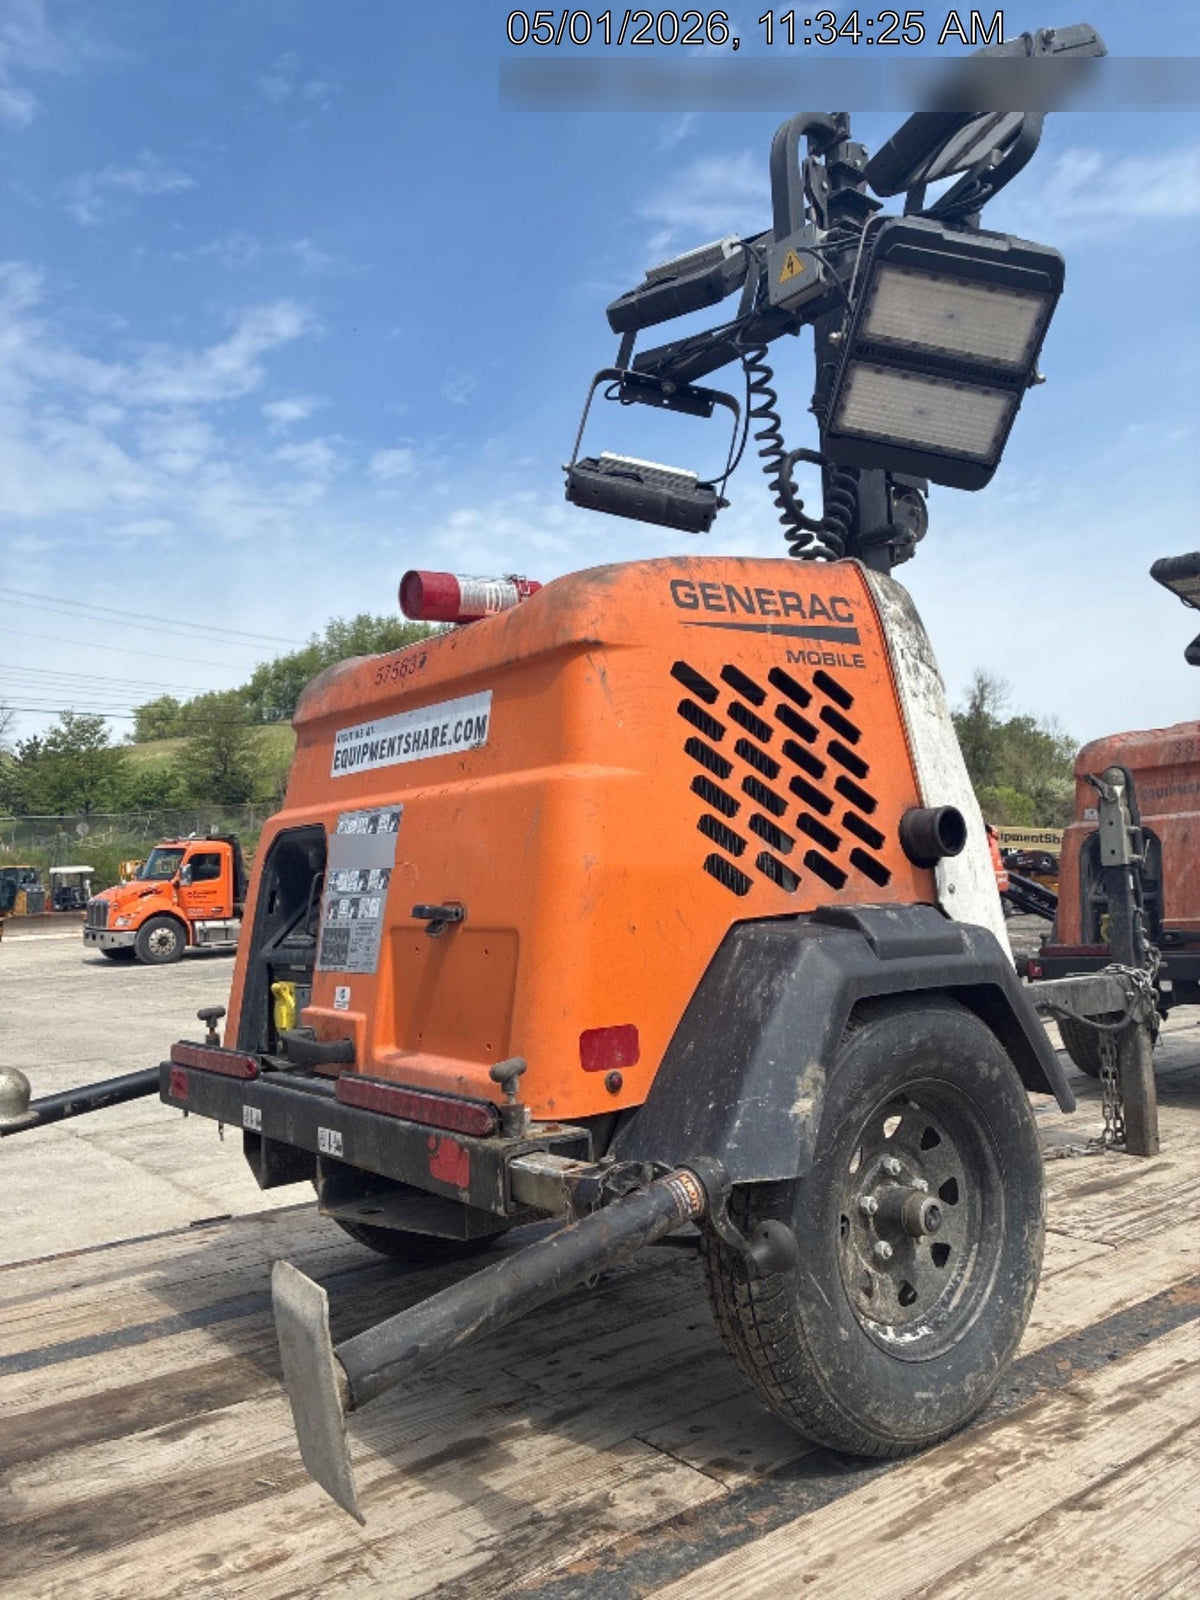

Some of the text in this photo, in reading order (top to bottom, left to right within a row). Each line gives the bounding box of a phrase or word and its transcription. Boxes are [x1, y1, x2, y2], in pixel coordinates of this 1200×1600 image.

[670, 579, 854, 622] GENERAC
[786, 650, 866, 669] MOBILE
[334, 714, 487, 770] EQUIPMENTSHARE.COM
